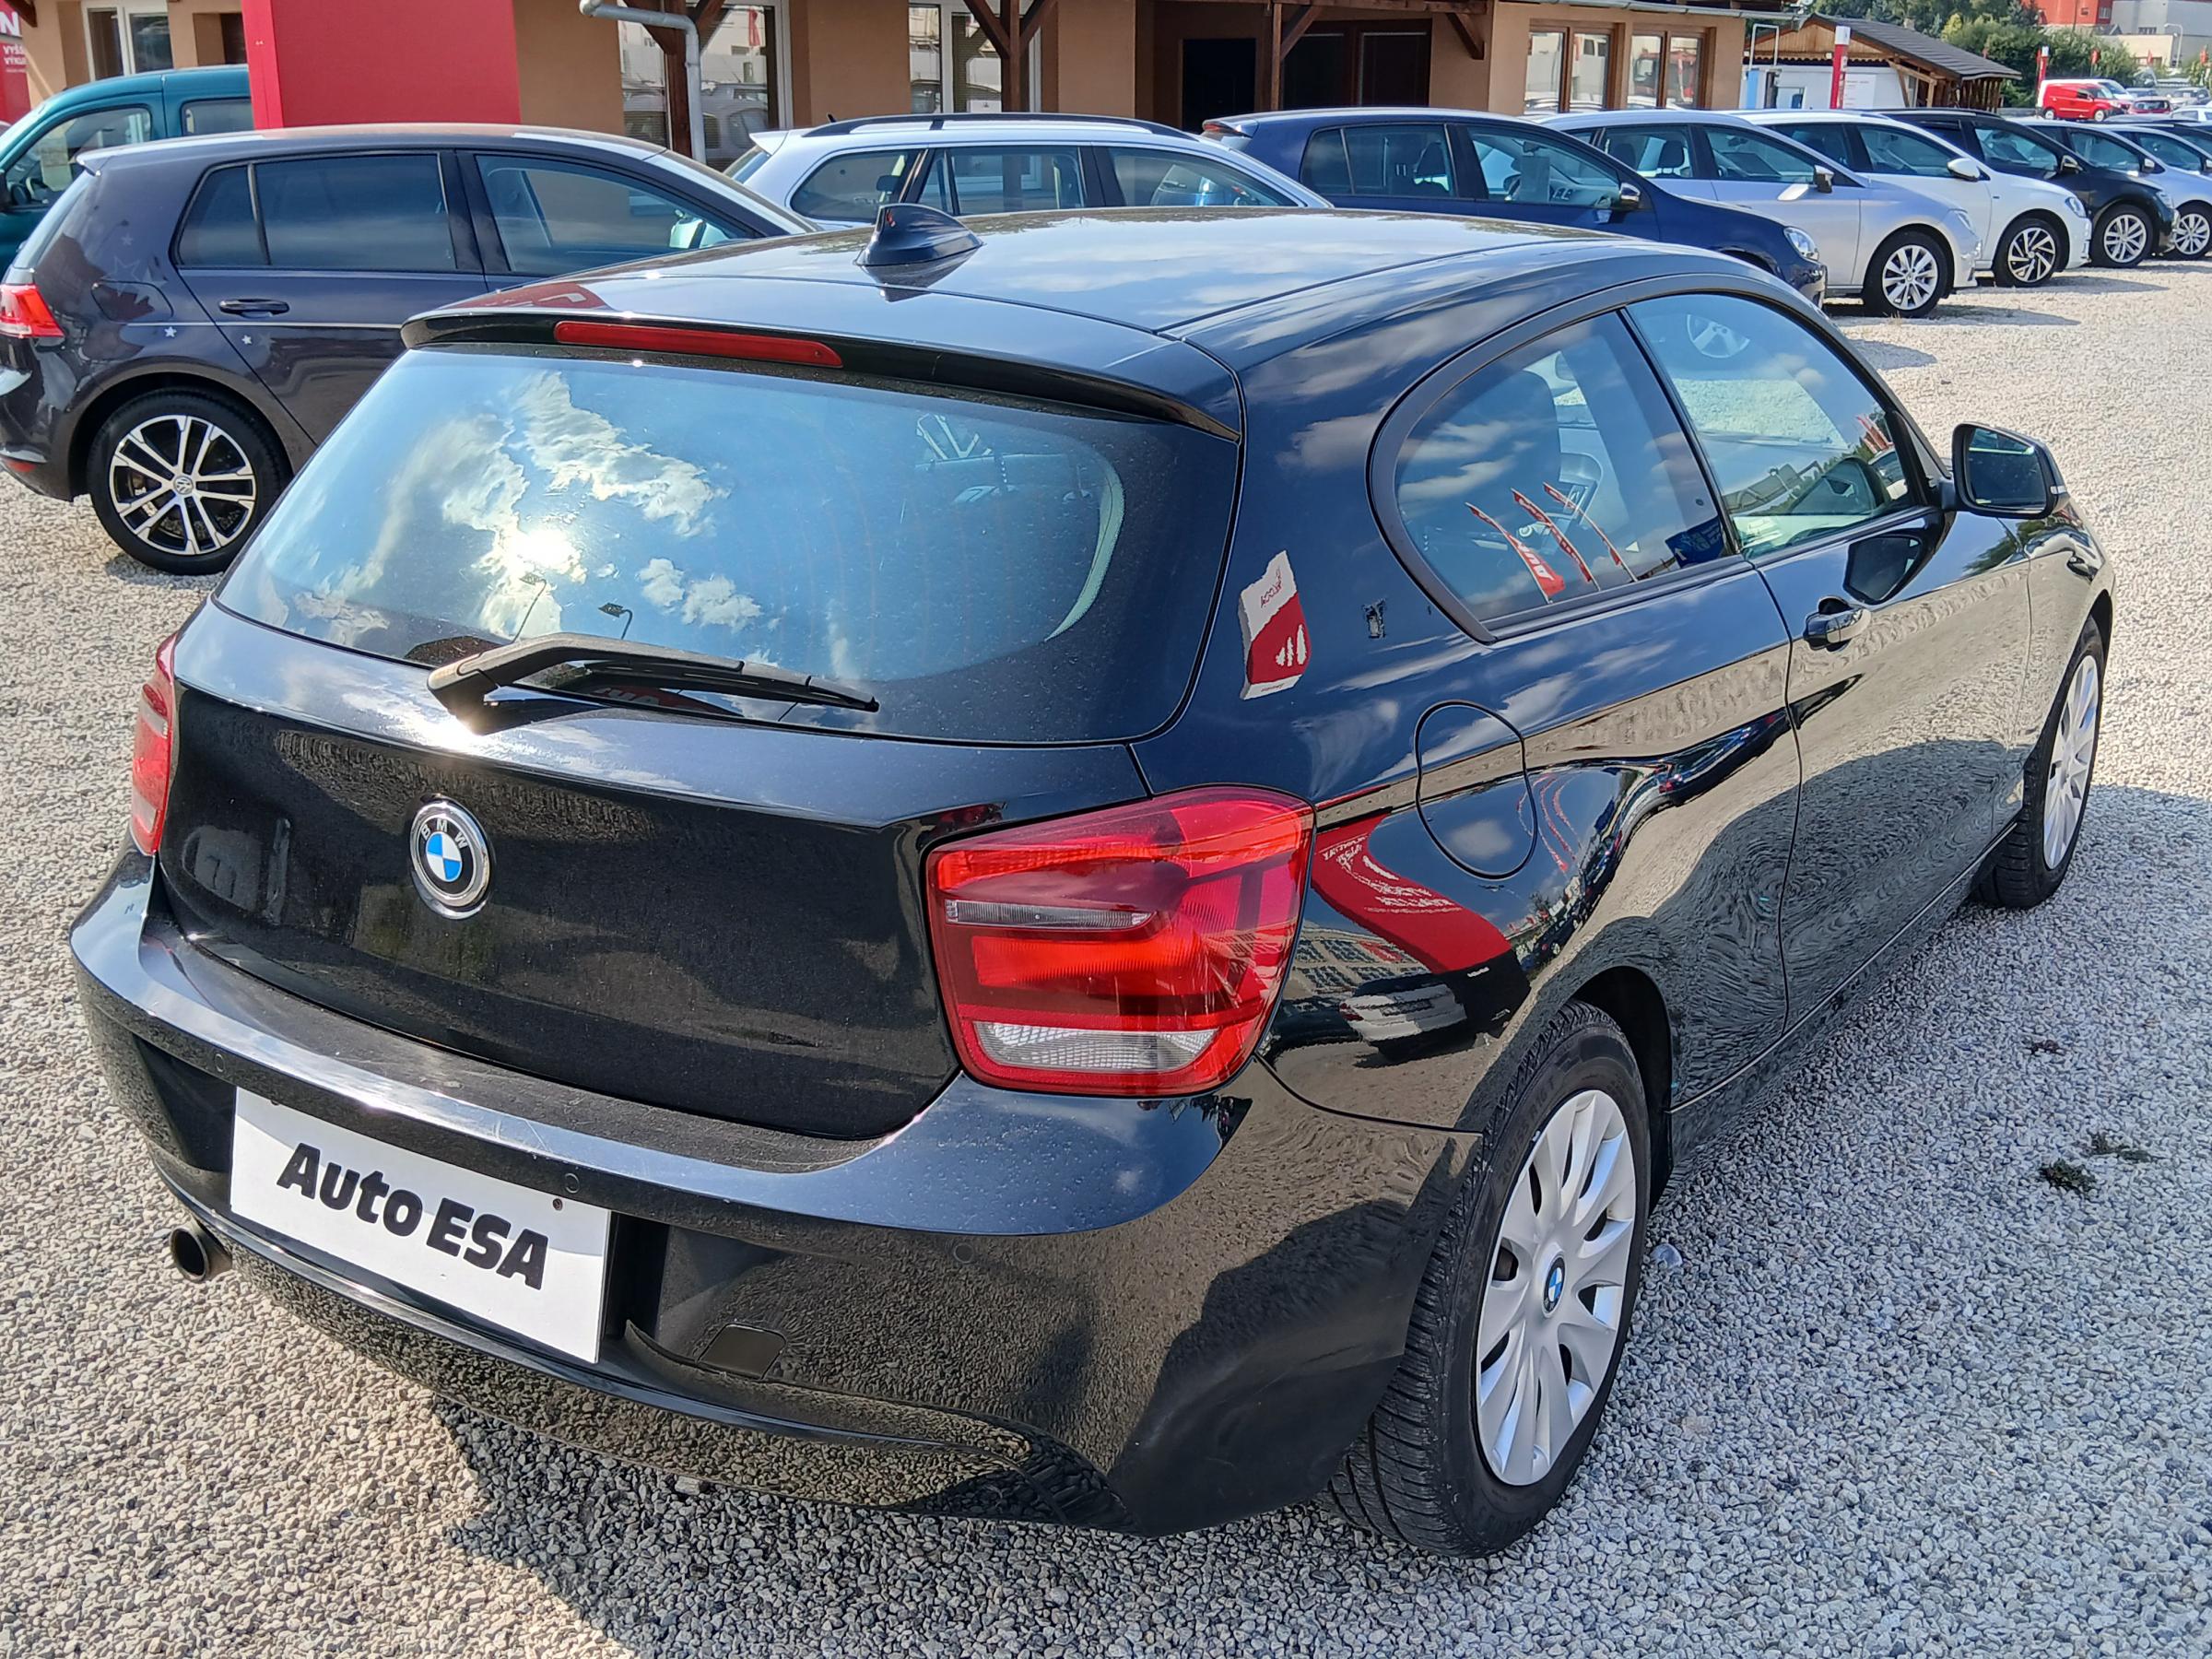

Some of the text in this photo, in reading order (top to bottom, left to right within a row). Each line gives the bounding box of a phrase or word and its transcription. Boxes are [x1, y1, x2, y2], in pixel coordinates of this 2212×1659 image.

[420, 818, 468, 849] BMW
[276, 1142, 549, 1290] Auto ESA
